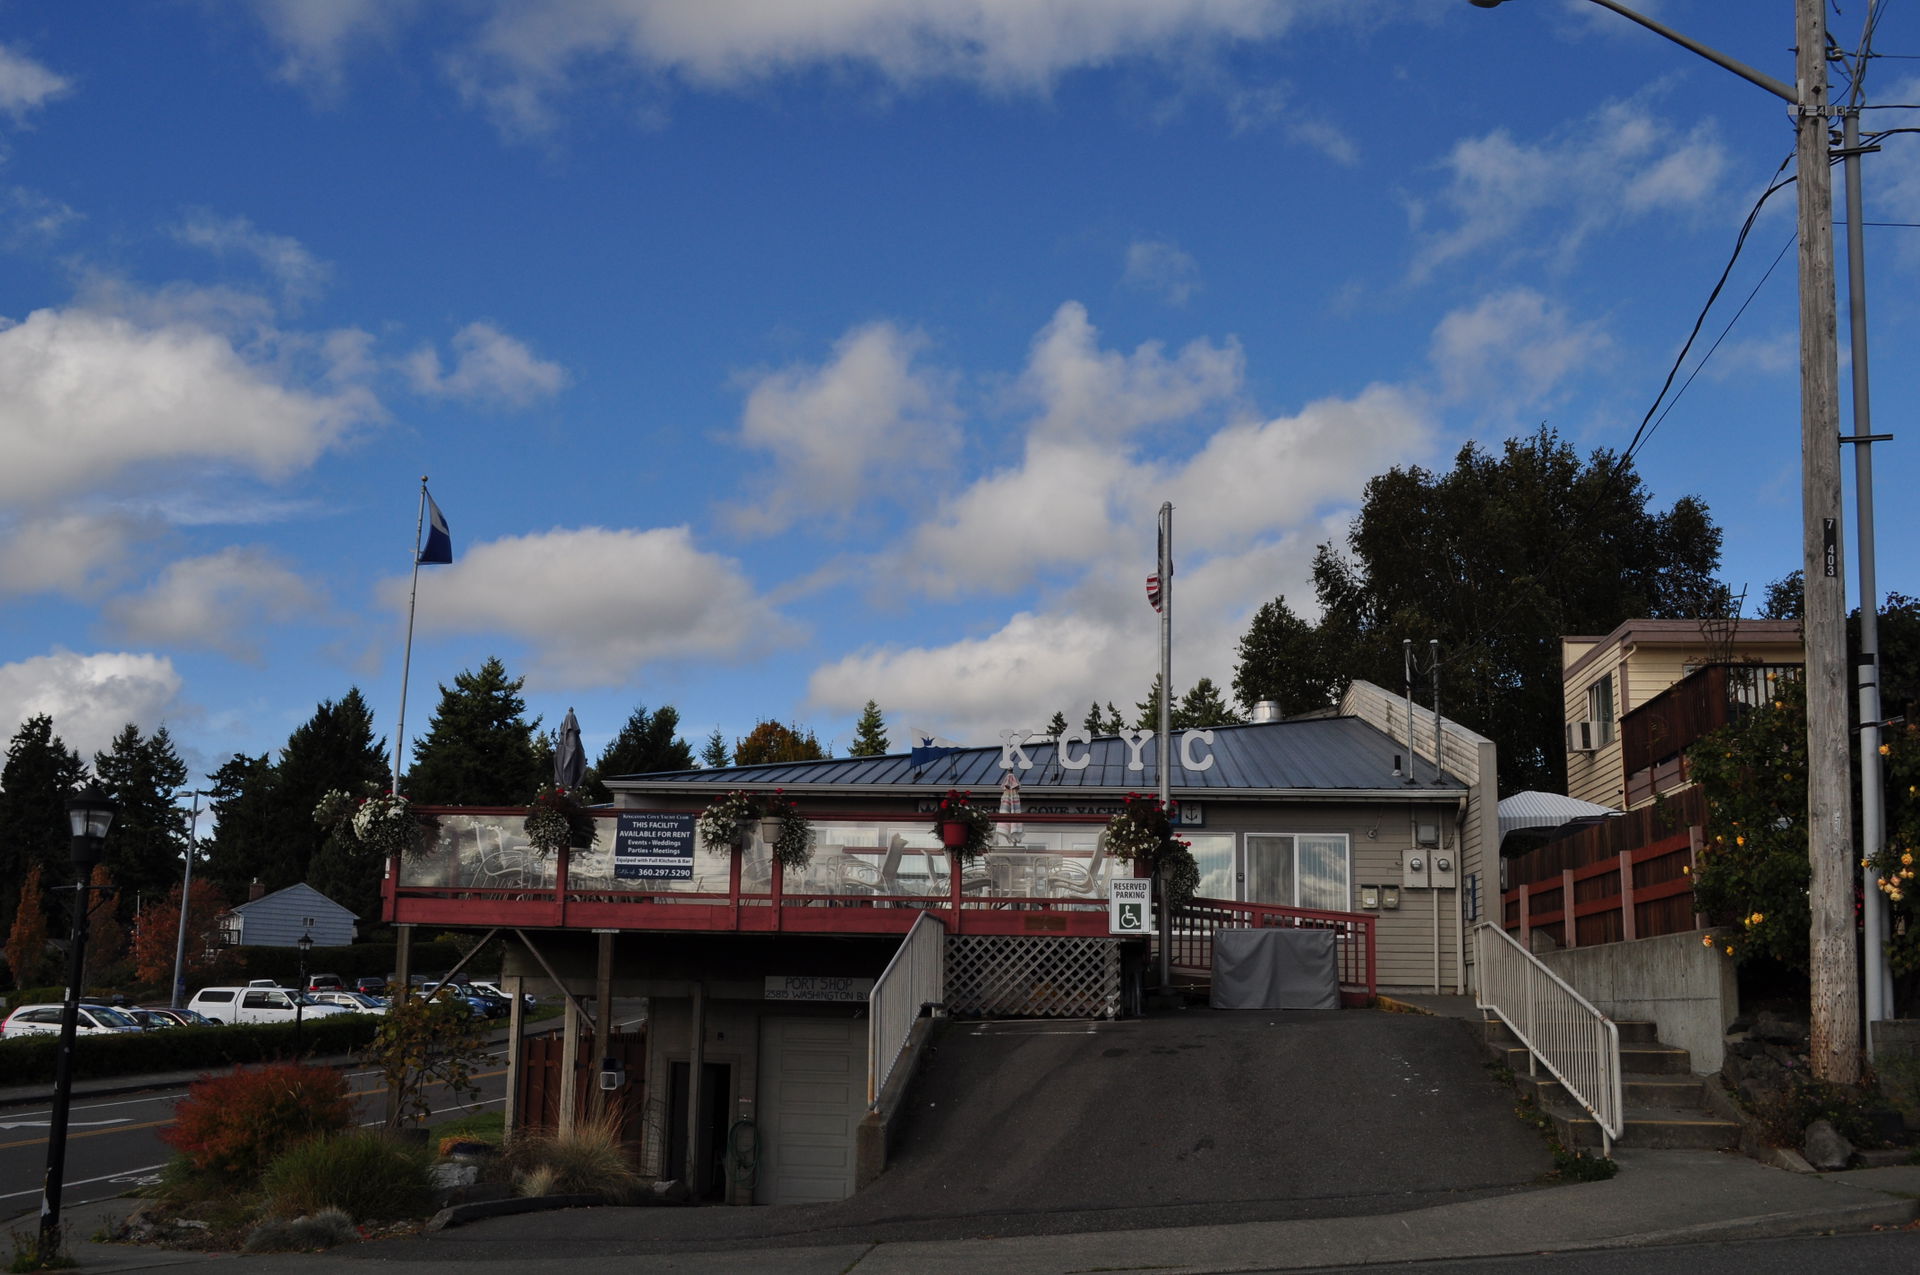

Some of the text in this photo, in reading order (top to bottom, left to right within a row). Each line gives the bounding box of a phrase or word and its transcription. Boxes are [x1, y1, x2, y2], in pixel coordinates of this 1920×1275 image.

[1827, 544, 1835, 576] 403
[649, 821, 679, 829] FACILITY
[651, 839, 681, 847] Weddings
[652, 847, 680, 855] Meetings
[638, 868, 690, 877] 360.297.5290
[1113, 882, 1147, 899] RESERVED PARKING
[785, 977, 853, 991] PORT SHOP
[792, 990, 853, 1000] WASHINGTON
